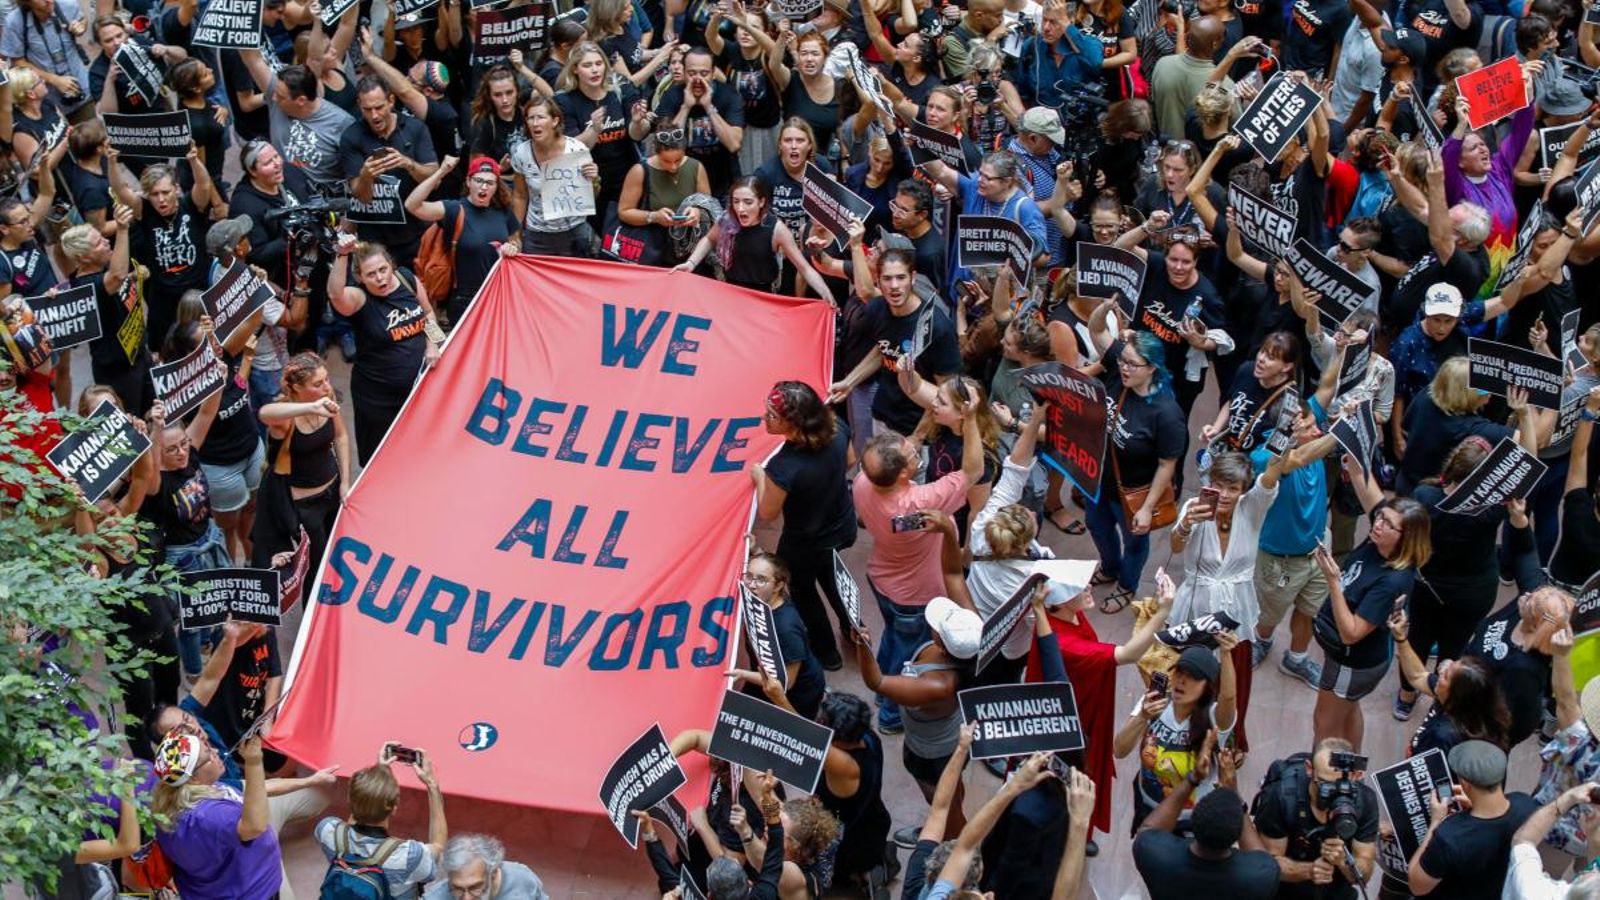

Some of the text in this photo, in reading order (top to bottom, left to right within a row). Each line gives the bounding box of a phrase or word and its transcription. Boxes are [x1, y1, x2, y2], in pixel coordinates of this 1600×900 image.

[227, 31, 258, 45] FORD
[480, 15, 544, 36] BELIEVE
[480, 29, 542, 45] SURVIVORS
[1475, 71, 1515, 96] BELIEVE
[1486, 90, 1506, 106] ALL
[107, 126, 189, 137] KAVANAUGH WAS A
[1263, 93, 1307, 145] OF LIES
[107, 136, 160, 146] DANGEROUS
[1242, 127, 1257, 144] A
[1230, 191, 1295, 244] NEVER
[152, 219, 191, 247] BE A
[959, 228, 991, 239] BRETT
[966, 240, 1007, 252] DEFINES
[1236, 211, 1290, 256] AGAIN
[155, 244, 196, 268] HERO
[215, 267, 252, 314] KAVANAUGH
[1078, 271, 1101, 285] LIED
[1289, 253, 1366, 313] BEWARE
[35, 296, 96, 323] VANAUGH
[226, 295, 248, 320] UNDER
[602, 302, 712, 377] WE
[1470, 352, 1563, 386] SEXUAL PREDATORS
[1472, 363, 1559, 395] MUST BE STOPPED
[1024, 372, 1097, 402] WOMEN
[218, 393, 250, 421] RESIS
[1229, 391, 1255, 416] BE
[465, 377, 764, 474] BELIEVE
[80, 466, 100, 484] IS
[1477, 445, 1525, 498] KAVANAUGH
[1502, 460, 1533, 495] HUBRIS
[495, 498, 630, 570] ALL
[210, 578, 262, 591] RISTINE
[239, 589, 271, 604] FORD
[197, 601, 228, 617] 100%
[231, 600, 281, 617] CERTAIN
[319, 536, 736, 672] SURVIVORS
[753, 603, 769, 637] HILL
[976, 698, 1063, 721] KAVANAUGH
[719, 711, 824, 761] THE FBI INVESTIGATION
[972, 715, 1079, 742] S BELLIGERENT
[638, 746, 660, 771] WAS
[658, 741, 669, 758] A
[730, 727, 805, 767] IS A WHITEWASH
[642, 754, 677, 788] DRUNK
[1410, 757, 1434, 793] BRETT
[1394, 769, 1430, 848] DEFINES HUB
